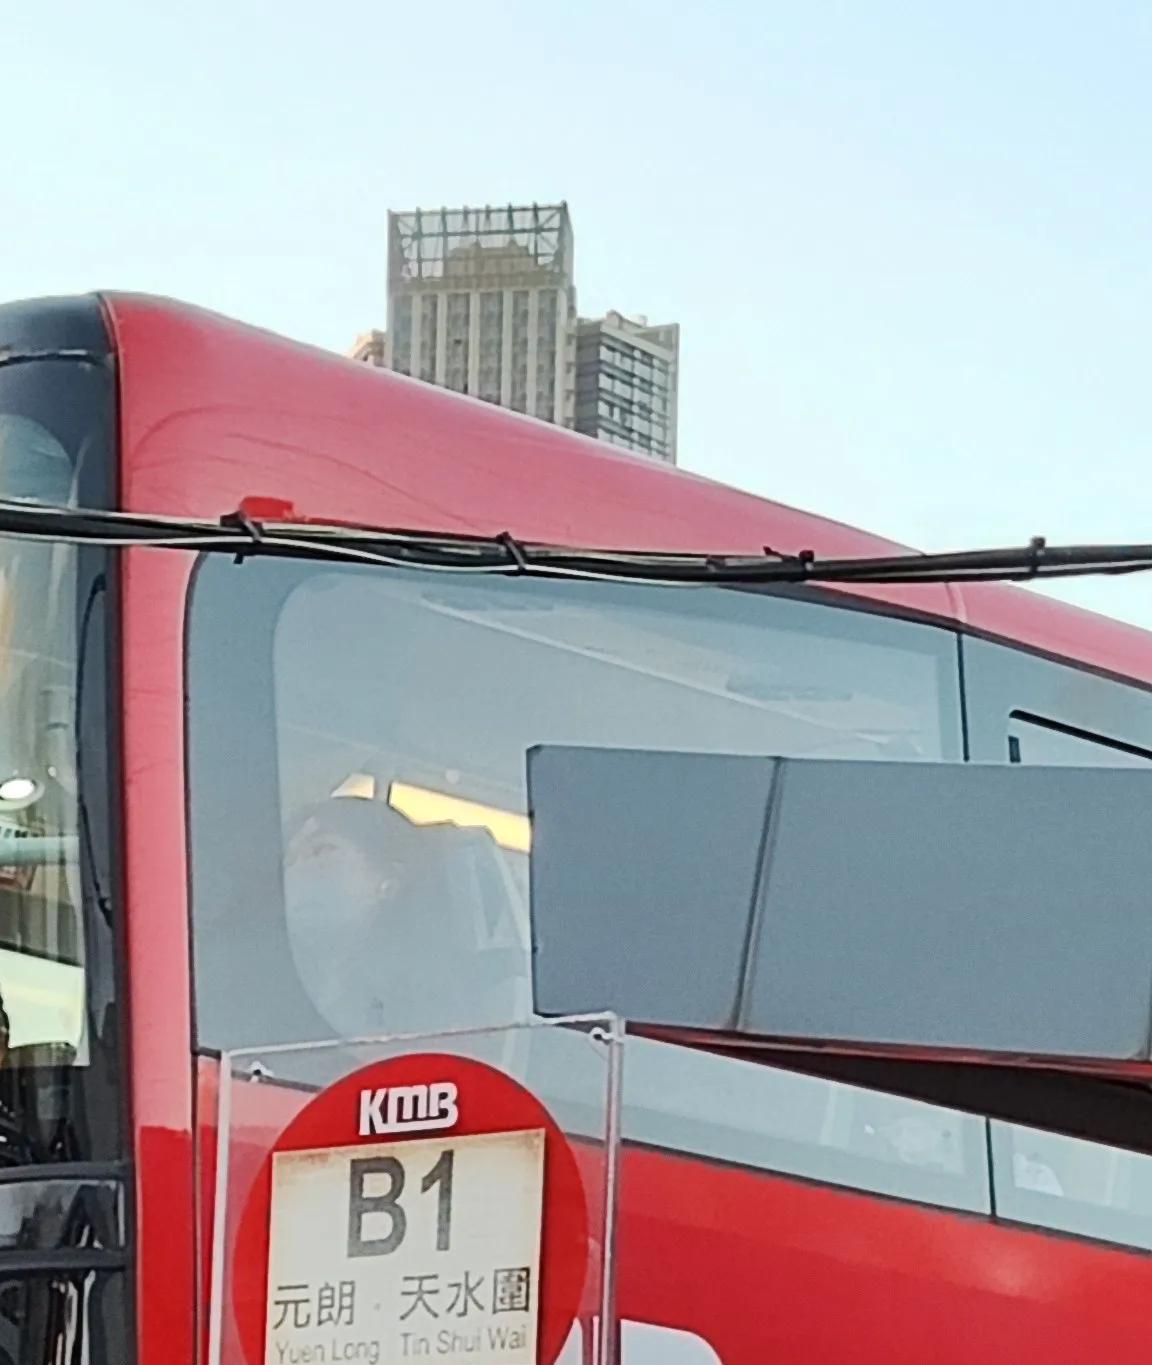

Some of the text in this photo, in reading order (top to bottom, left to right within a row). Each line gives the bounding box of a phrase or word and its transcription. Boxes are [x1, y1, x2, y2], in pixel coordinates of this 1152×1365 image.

[359, 1082, 459, 1135] KMB
[347, 1149, 455, 1258] B1
[273, 1280, 356, 1330] 元朗
[275, 1323, 527, 1365] Yuen Long Tin Shui Wai
